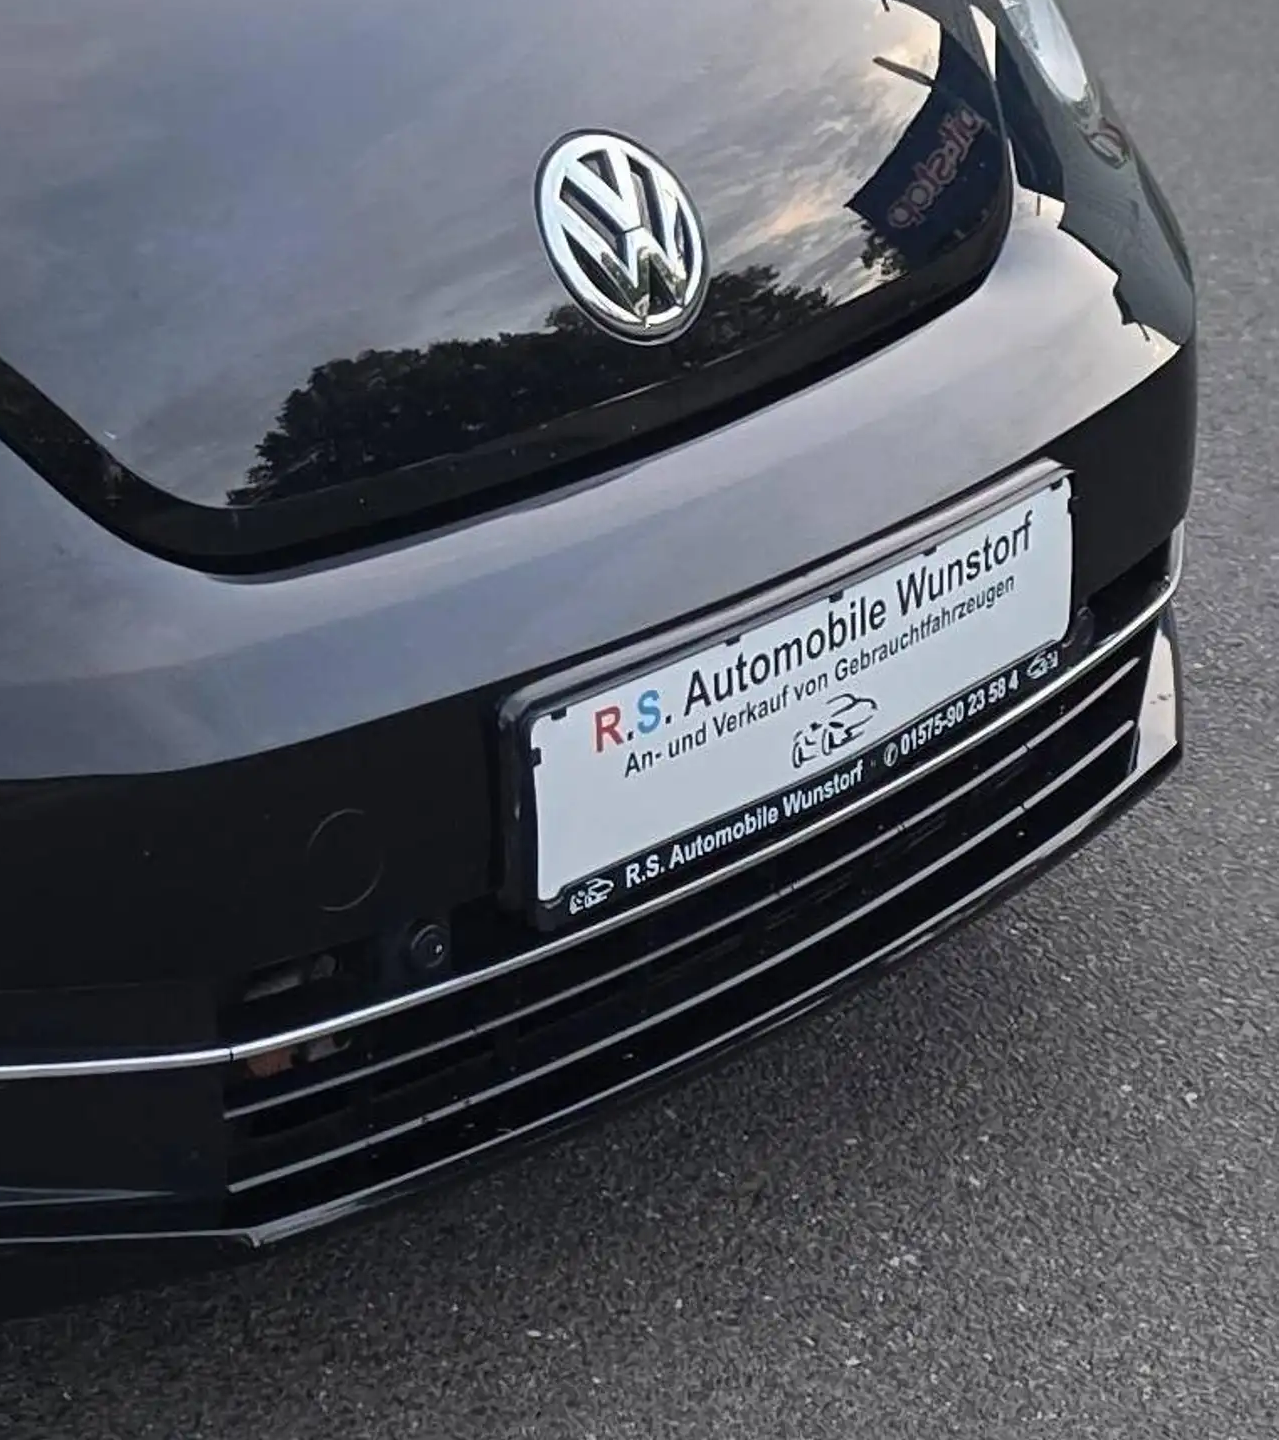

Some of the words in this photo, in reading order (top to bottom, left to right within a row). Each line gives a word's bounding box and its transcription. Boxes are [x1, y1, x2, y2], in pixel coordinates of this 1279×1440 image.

[594, 688, 672, 754] R.S.
[683, 596, 887, 717] Automobile
[895, 509, 1034, 618] Wunstorf
[624, 751, 663, 779] An-
[668, 721, 708, 759] und
[712, 683, 790, 739] Verkauf
[793, 671, 829, 703] von
[834, 574, 1016, 682] Gebrauchtfahrzeugen
[624, 854, 667, 890] R.S.
[668, 805, 779, 870] Automobile
[782, 758, 864, 818] Wunstorf
[900, 700, 966, 756] 01575-90
[967, 688, 987, 717] 23
[988, 676, 1007, 704] 58
